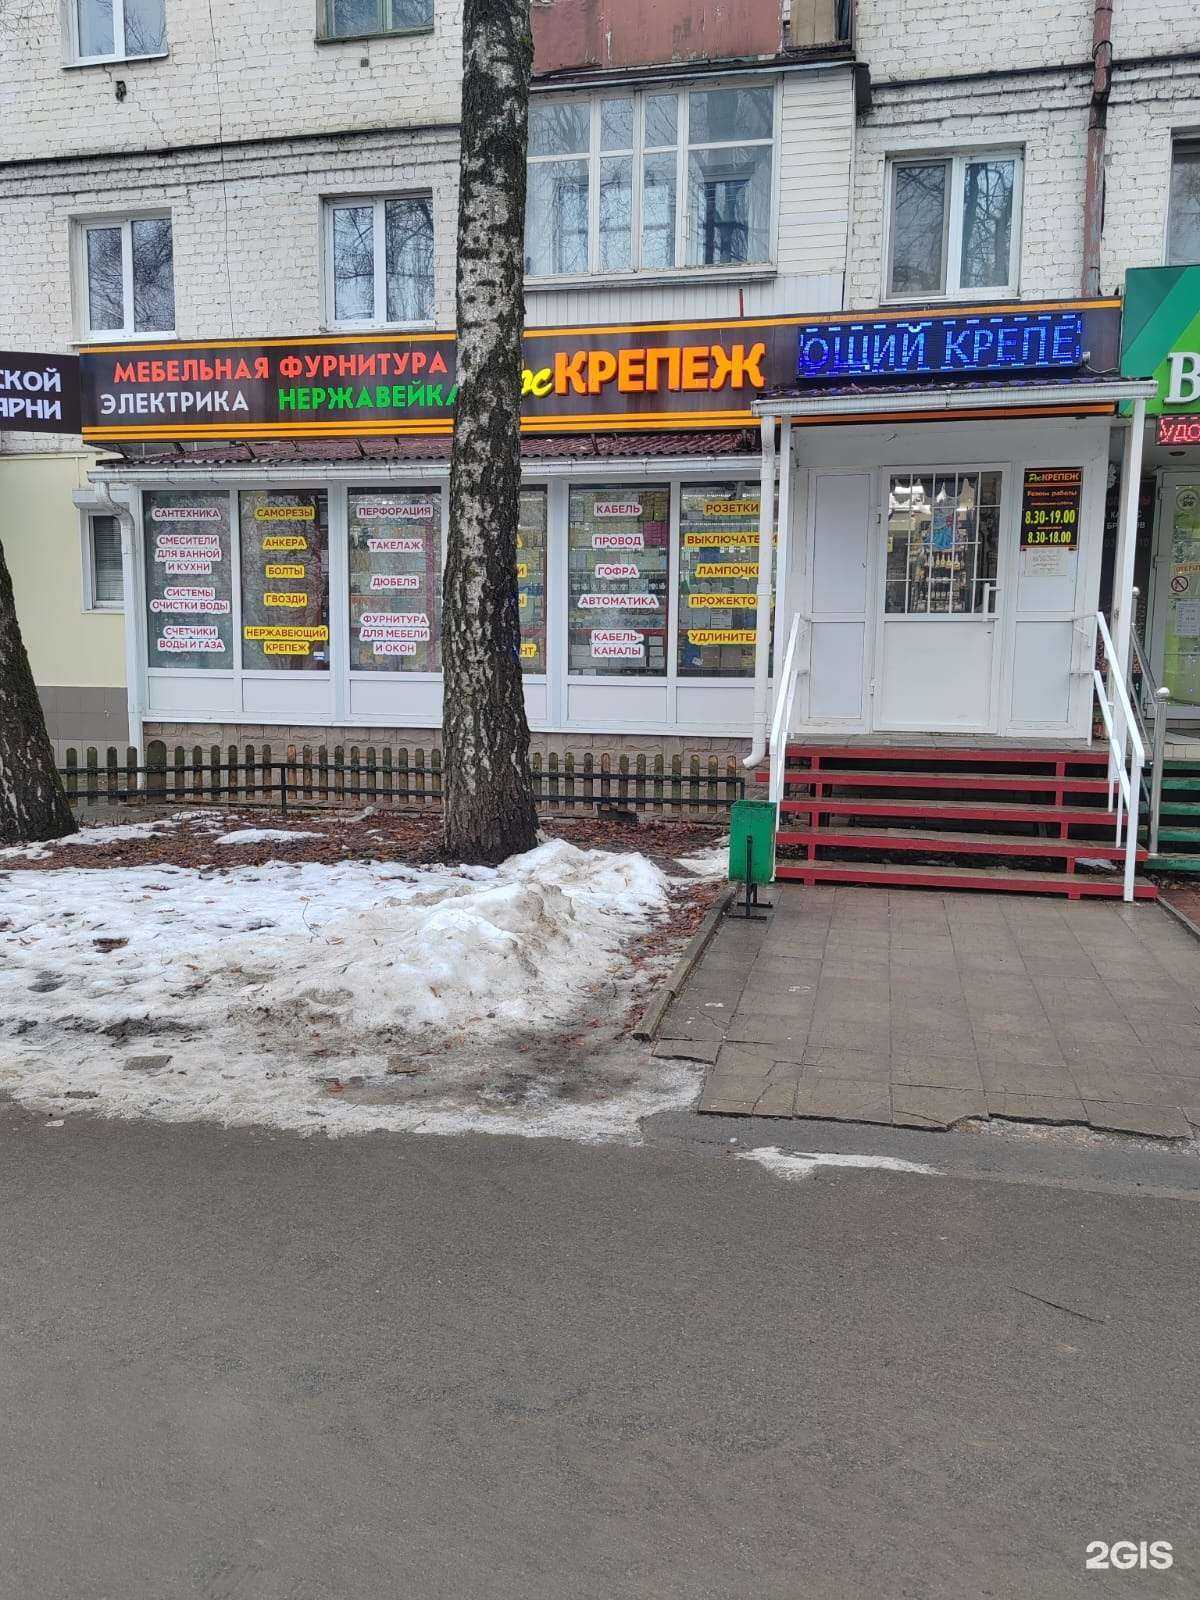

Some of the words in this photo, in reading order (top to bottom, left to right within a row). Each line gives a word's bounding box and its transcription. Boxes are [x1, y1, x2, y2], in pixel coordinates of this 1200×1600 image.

[113, 356, 270, 384] МЕБЕЛЬНАЯ
[279, 351, 448, 378] ФУРНИТУРА
[100, 390, 249, 416] ЭЛЕКТРИКА
[154, 509, 219, 518] САНТЕХНИКА
[257, 508, 313, 517] САМОРЕЗЫ
[358, 507, 431, 517] ПЕРФОРАЦИЯ
[596, 504, 640, 514] КАБЕЛЬ
[706, 504, 759, 513] РОЗЕТКИ
[1025, 510, 1076, 524] 8.30-19.00
[159, 537, 217, 545] СМЕСИТЕЛИ
[265, 538, 305, 547] АНКЕРА
[594, 536, 641, 546] ПРОВОД
[1027, 531, 1072, 544] 8.30-18.00
[370, 541, 420, 550] ТАКЕЛАЖ
[157, 550, 177, 559] ДЛЯ
[179, 549, 220, 559] ВАННОЙ
[168, 563, 175, 571] И
[177, 563, 210, 571] КУХНИ
[268, 566, 303, 576] БОЛТЫ
[598, 566, 636, 576] ГОФРА
[373, 577, 416, 588] ДЮБЕЛЯ
[166, 588, 213, 598] СИСТЕМЫ
[266, 595, 305, 605] ГВОЗДИ
[581, 597, 656, 606] АВТОМАТИКА
[152, 600, 198, 610] ОЧИСТКИ
[200, 601, 228, 611] ВОДЫ
[363, 615, 427, 624] ФУРНИТУРА
[165, 627, 216, 636] СЧЕТЧИКИ
[246, 626, 326, 639] НЕРЖАВЕЮЩИЙ
[362, 629, 384, 639] ДЛЯ
[386, 629, 427, 638] МЕБЕЛИ
[594, 632, 642, 641] КАБЕЛЬ-
[159, 640, 188, 649] ВОДЫ
[190, 641, 198, 649] И
[199, 640, 223, 650] ГАЗА
[266, 644, 307, 652] КРЕПЕЖ
[375, 644, 383, 652] И
[385, 644, 414, 653] ОКОН
[594, 647, 641, 656] КАНАЛЫ
